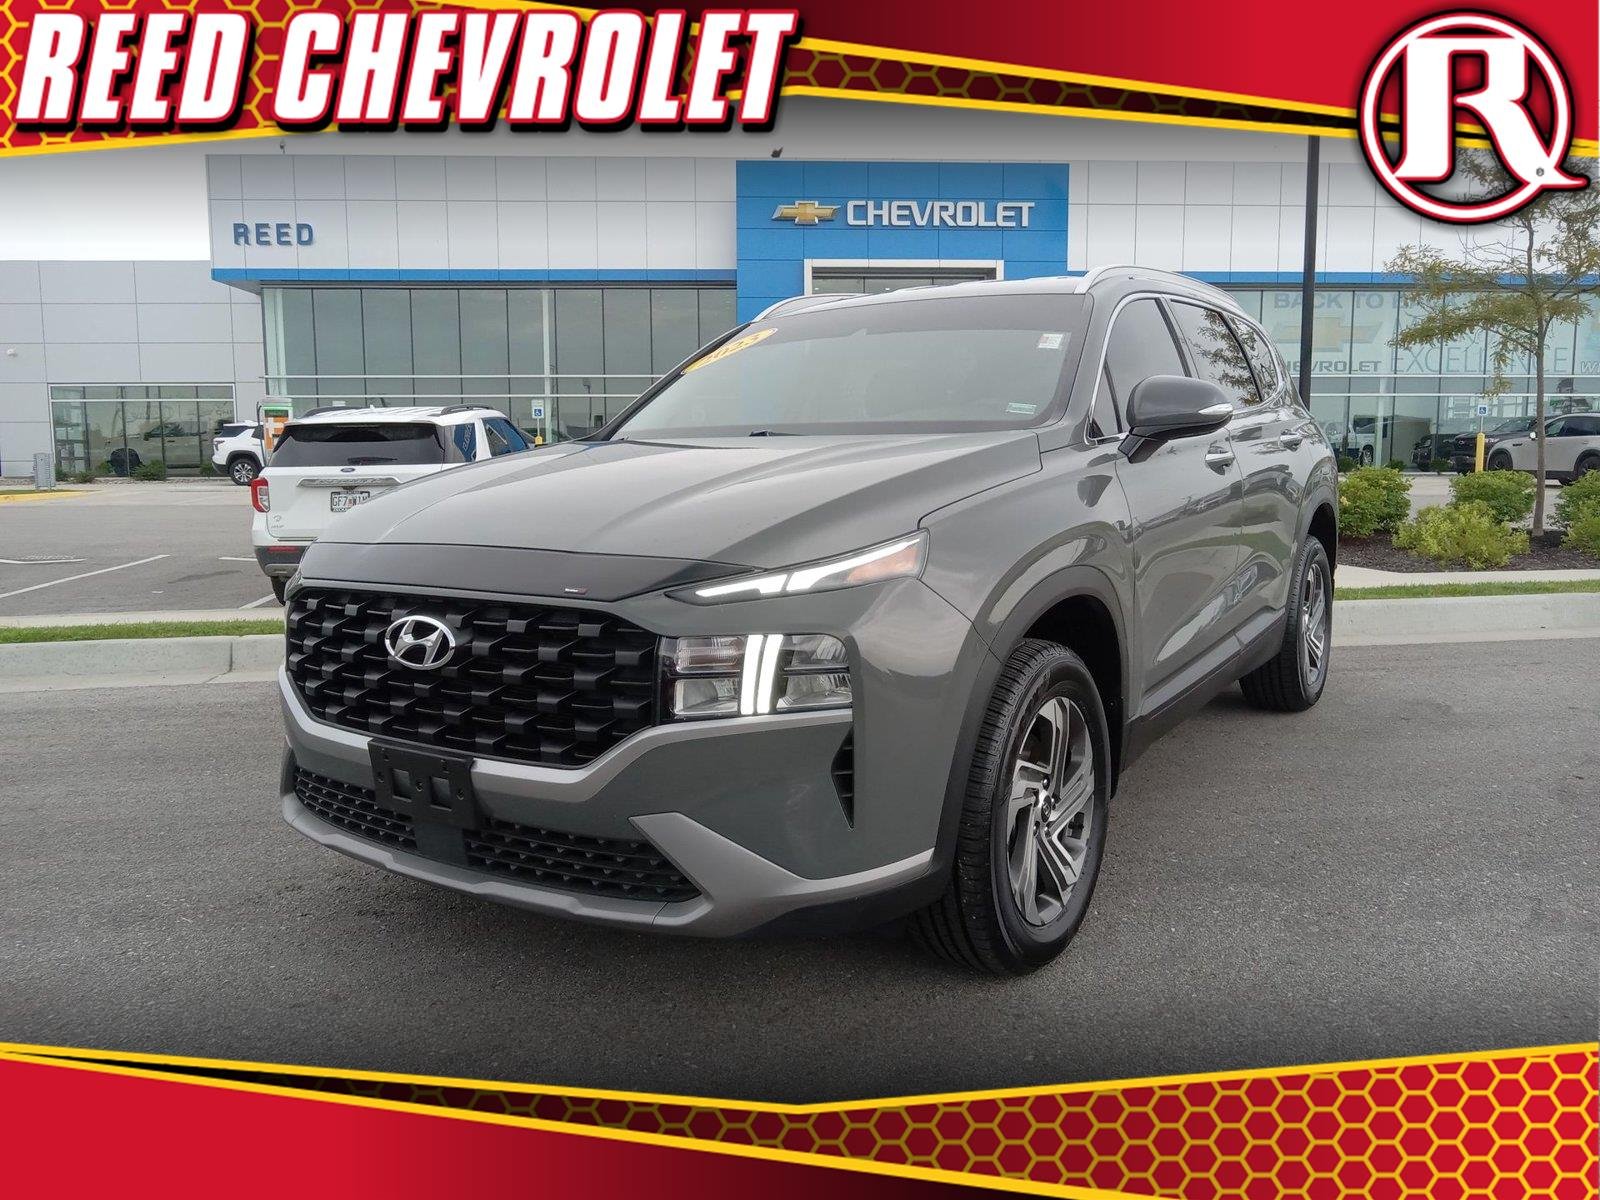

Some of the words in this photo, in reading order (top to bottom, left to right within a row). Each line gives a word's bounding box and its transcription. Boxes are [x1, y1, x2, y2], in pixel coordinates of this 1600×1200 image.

[846, 200, 1035, 227] CHEVROLET
[233, 223, 314, 245] REED
[1355, 292, 1384, 308] TO
